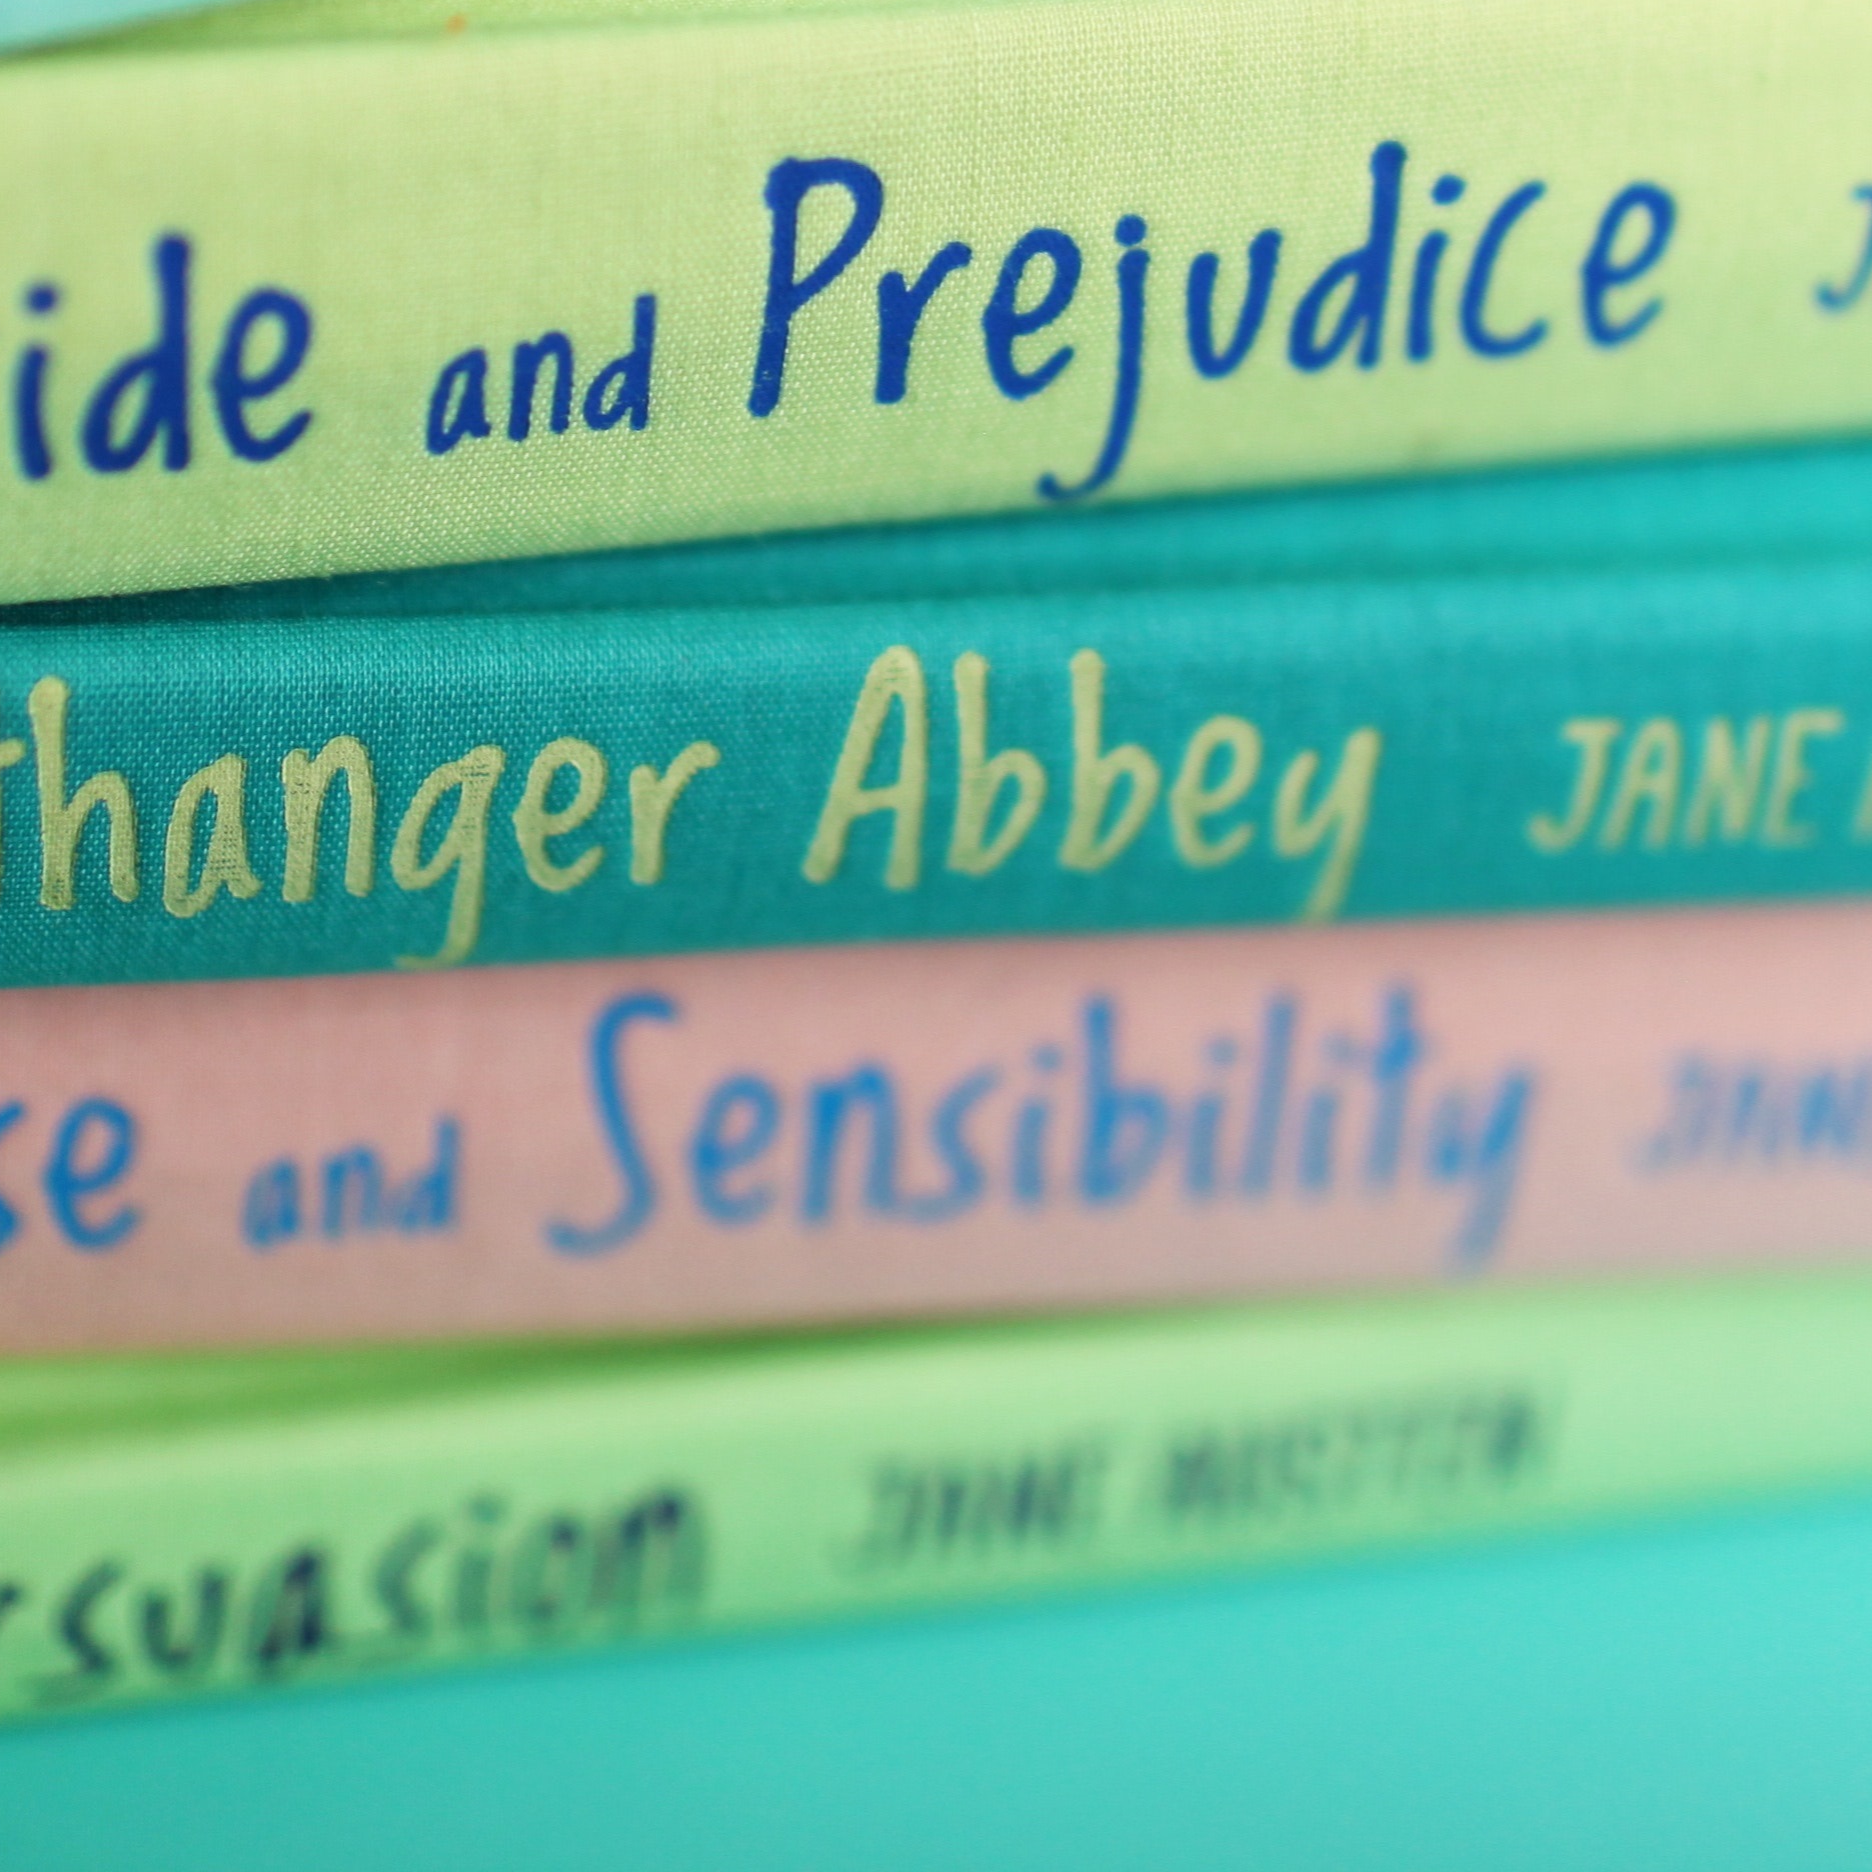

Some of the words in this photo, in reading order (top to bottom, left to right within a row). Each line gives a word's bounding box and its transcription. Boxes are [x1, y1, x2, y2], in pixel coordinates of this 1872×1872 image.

[424, 290, 658, 456] and
[747, 140, 1678, 503] Prejudice
[803, 644, 1382, 923] Abbey
[1525, 707, 1846, 854] JANE
[240, 1113, 468, 1253] and
[540, 979, 1537, 1274] Sensibility
